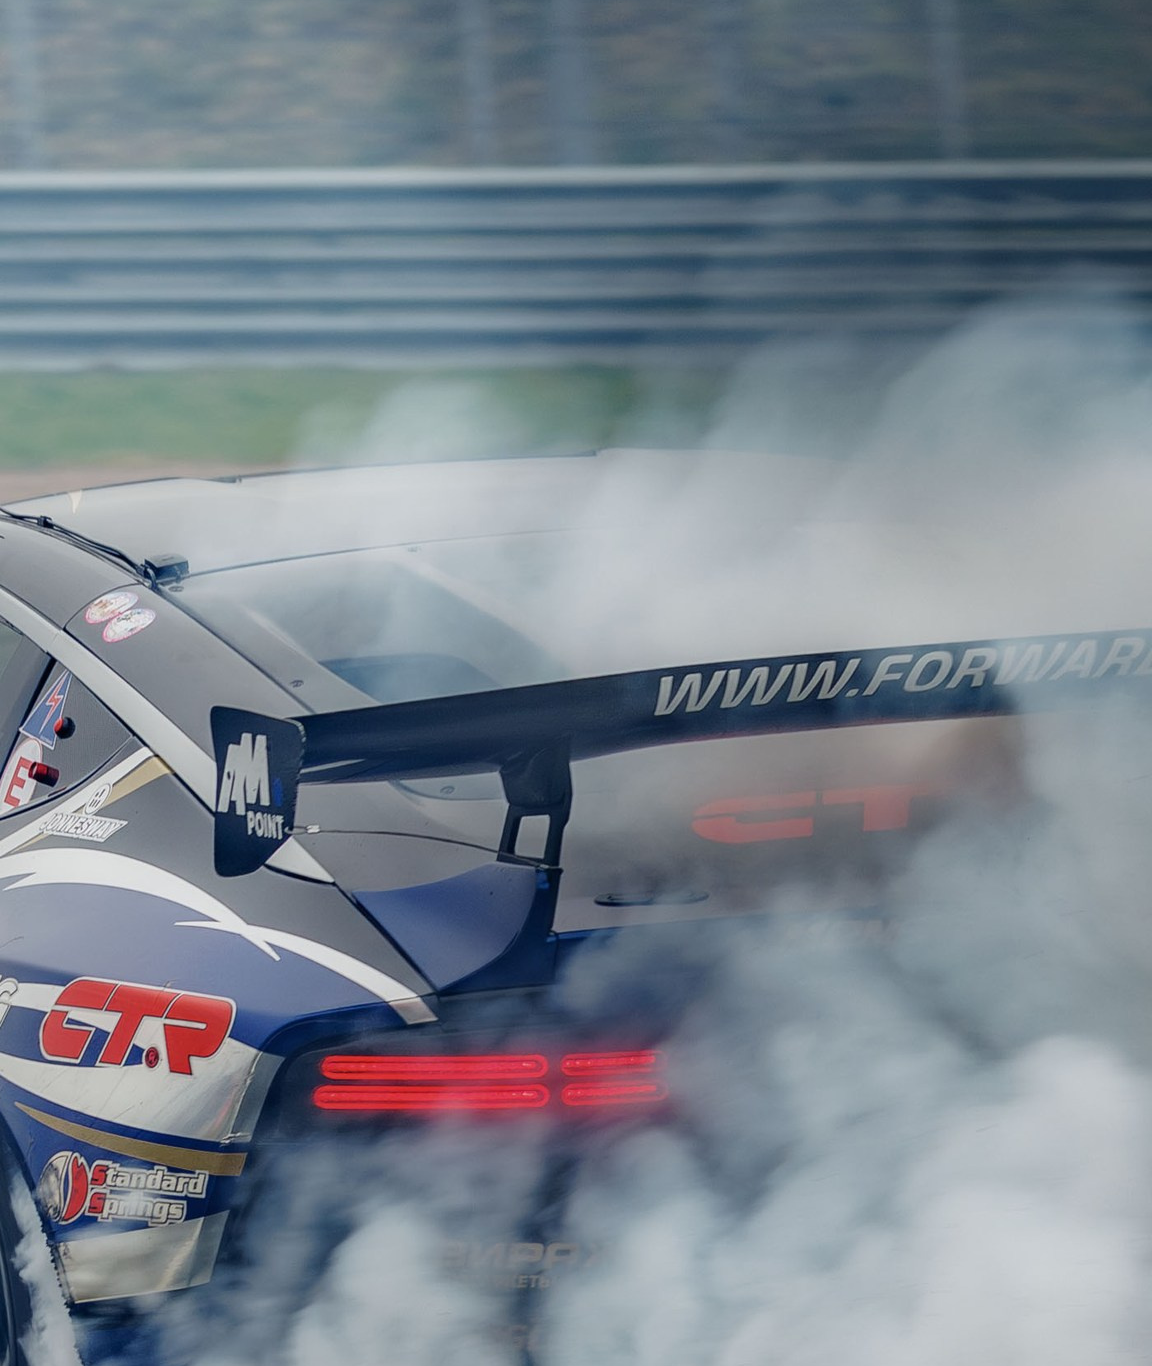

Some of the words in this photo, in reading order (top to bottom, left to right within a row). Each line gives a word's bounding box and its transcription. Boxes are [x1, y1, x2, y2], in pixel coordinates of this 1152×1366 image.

[654, 636, 1152, 717] WWW.FORWAR
[39, 813, 122, 841] JONNESWAY
[247, 810, 285, 840] POINT
[41, 977, 236, 1076] CTR
[89, 1161, 209, 1197] Standard
[87, 1191, 186, 1226] Springs
